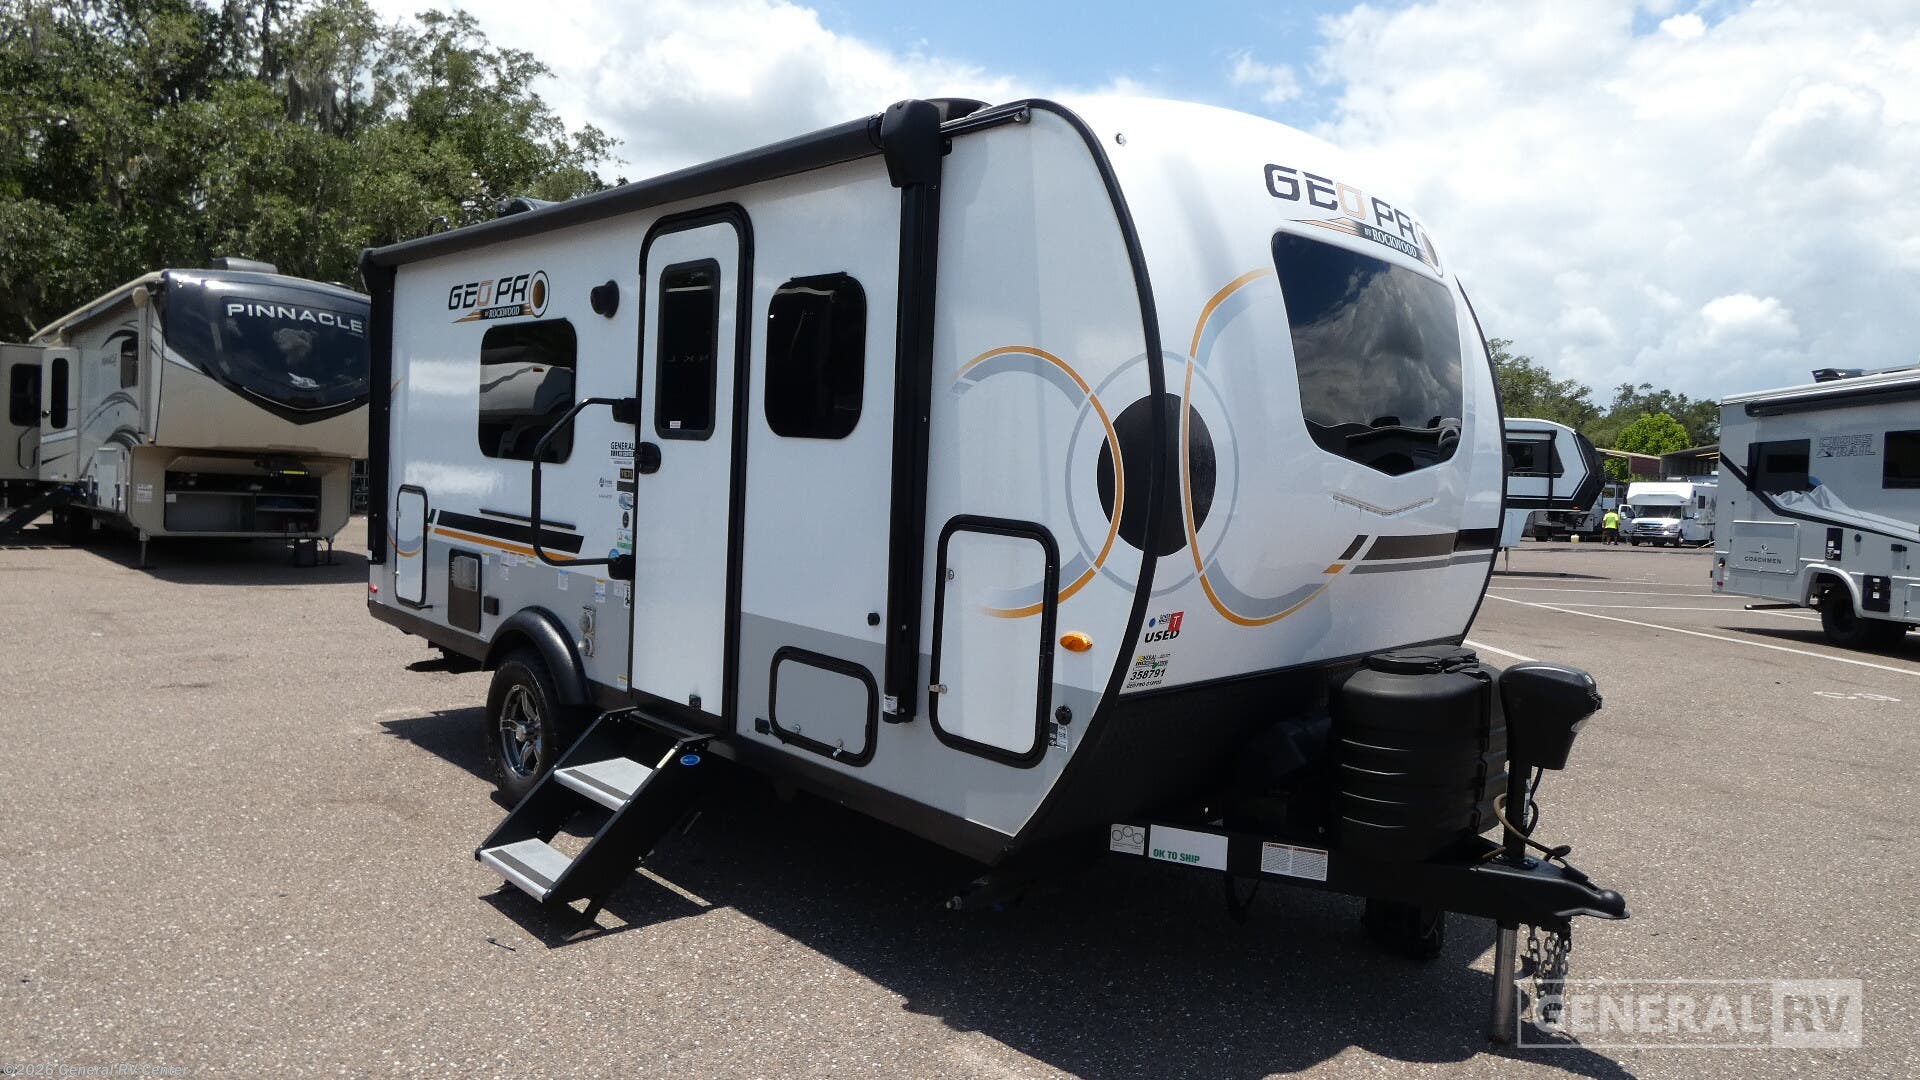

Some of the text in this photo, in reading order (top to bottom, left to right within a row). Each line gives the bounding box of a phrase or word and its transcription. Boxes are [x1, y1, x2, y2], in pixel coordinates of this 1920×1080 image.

[1264, 163, 1444, 278] GEO PRO
[1371, 229, 1417, 257] ROCKWOOD
[448, 270, 550, 318] GEO PRO
[227, 304, 363, 333] PINNACLE
[488, 306, 520, 318] ROCKWOOD
[610, 441, 635, 450] GENERAL
[1831, 444, 1876, 457] TRAIL
[1744, 556, 1782, 564] COACHMEN
[1144, 630, 1179, 643] USED
[1130, 668, 1166, 681] 358791
[1153, 848, 1165, 858] OK
[1167, 850, 1178, 860] TO
[1179, 853, 1200, 863] SHIP
